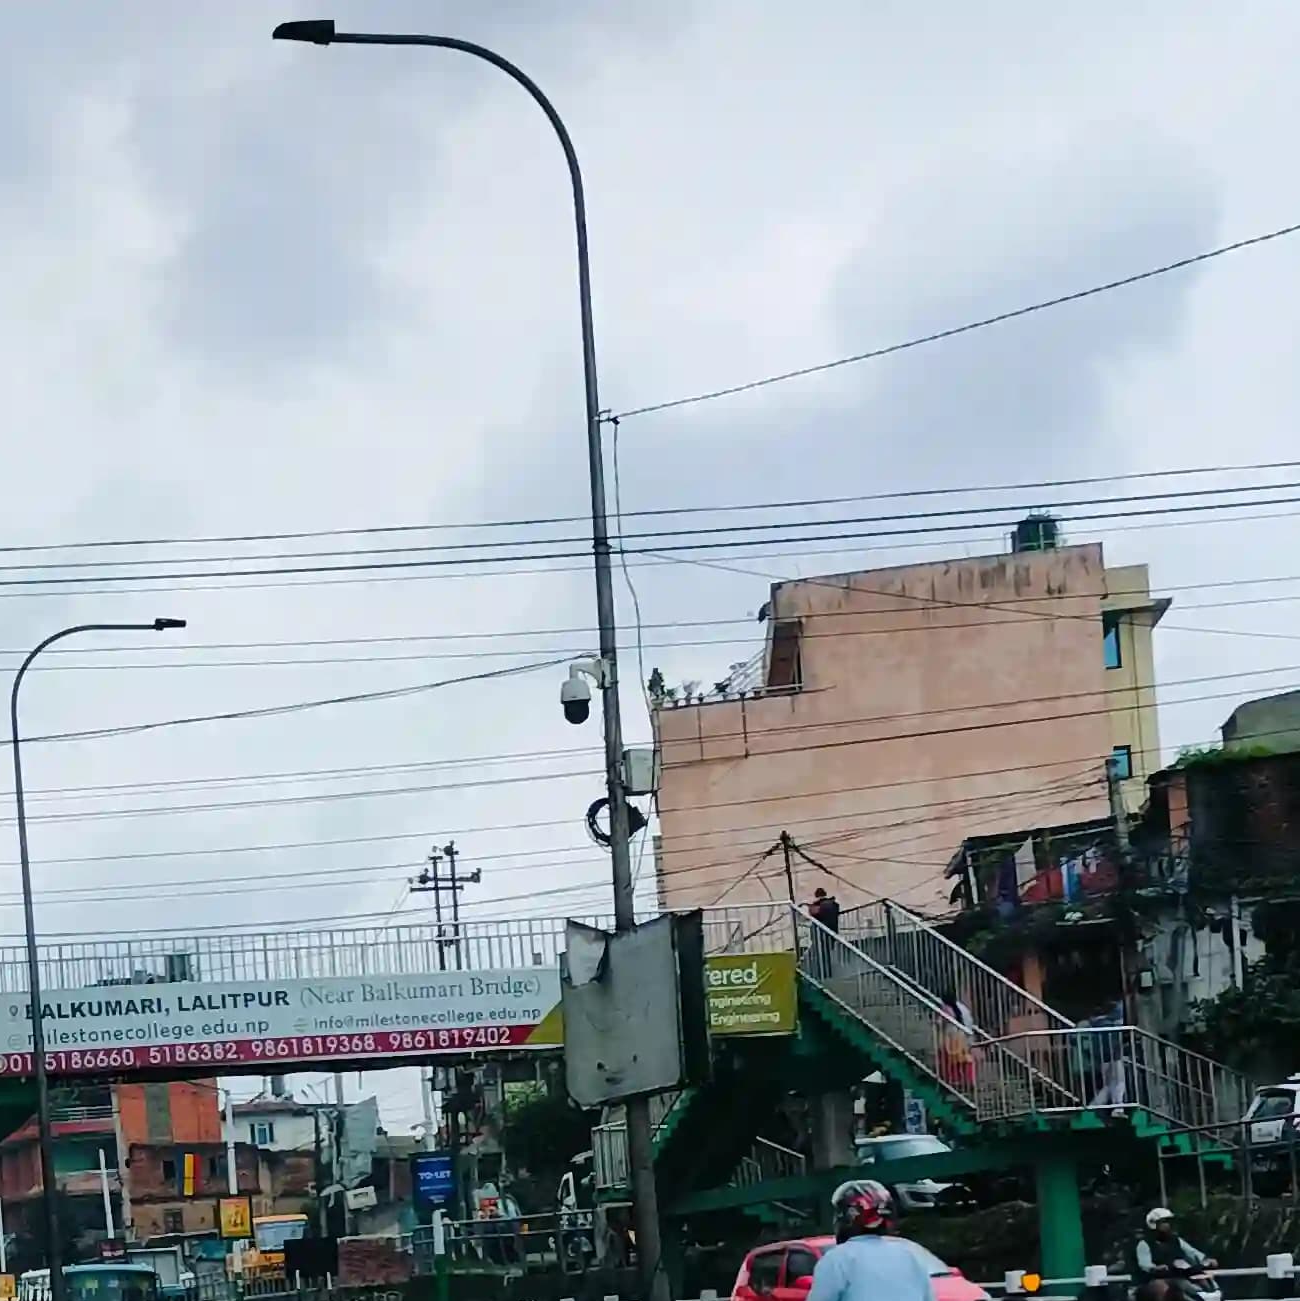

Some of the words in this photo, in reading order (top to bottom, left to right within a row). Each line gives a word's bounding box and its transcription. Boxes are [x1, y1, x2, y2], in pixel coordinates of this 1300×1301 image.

[177, 990, 290, 1013] LALITPUR
[300, 985, 355, 1009] (Near
[360, 981, 463, 1003] Balkumari
[470, 975, 541, 999] Bridge)
[710, 1011, 780, 1026] Engineering
[388, 1026, 511, 1050] 9861819402
